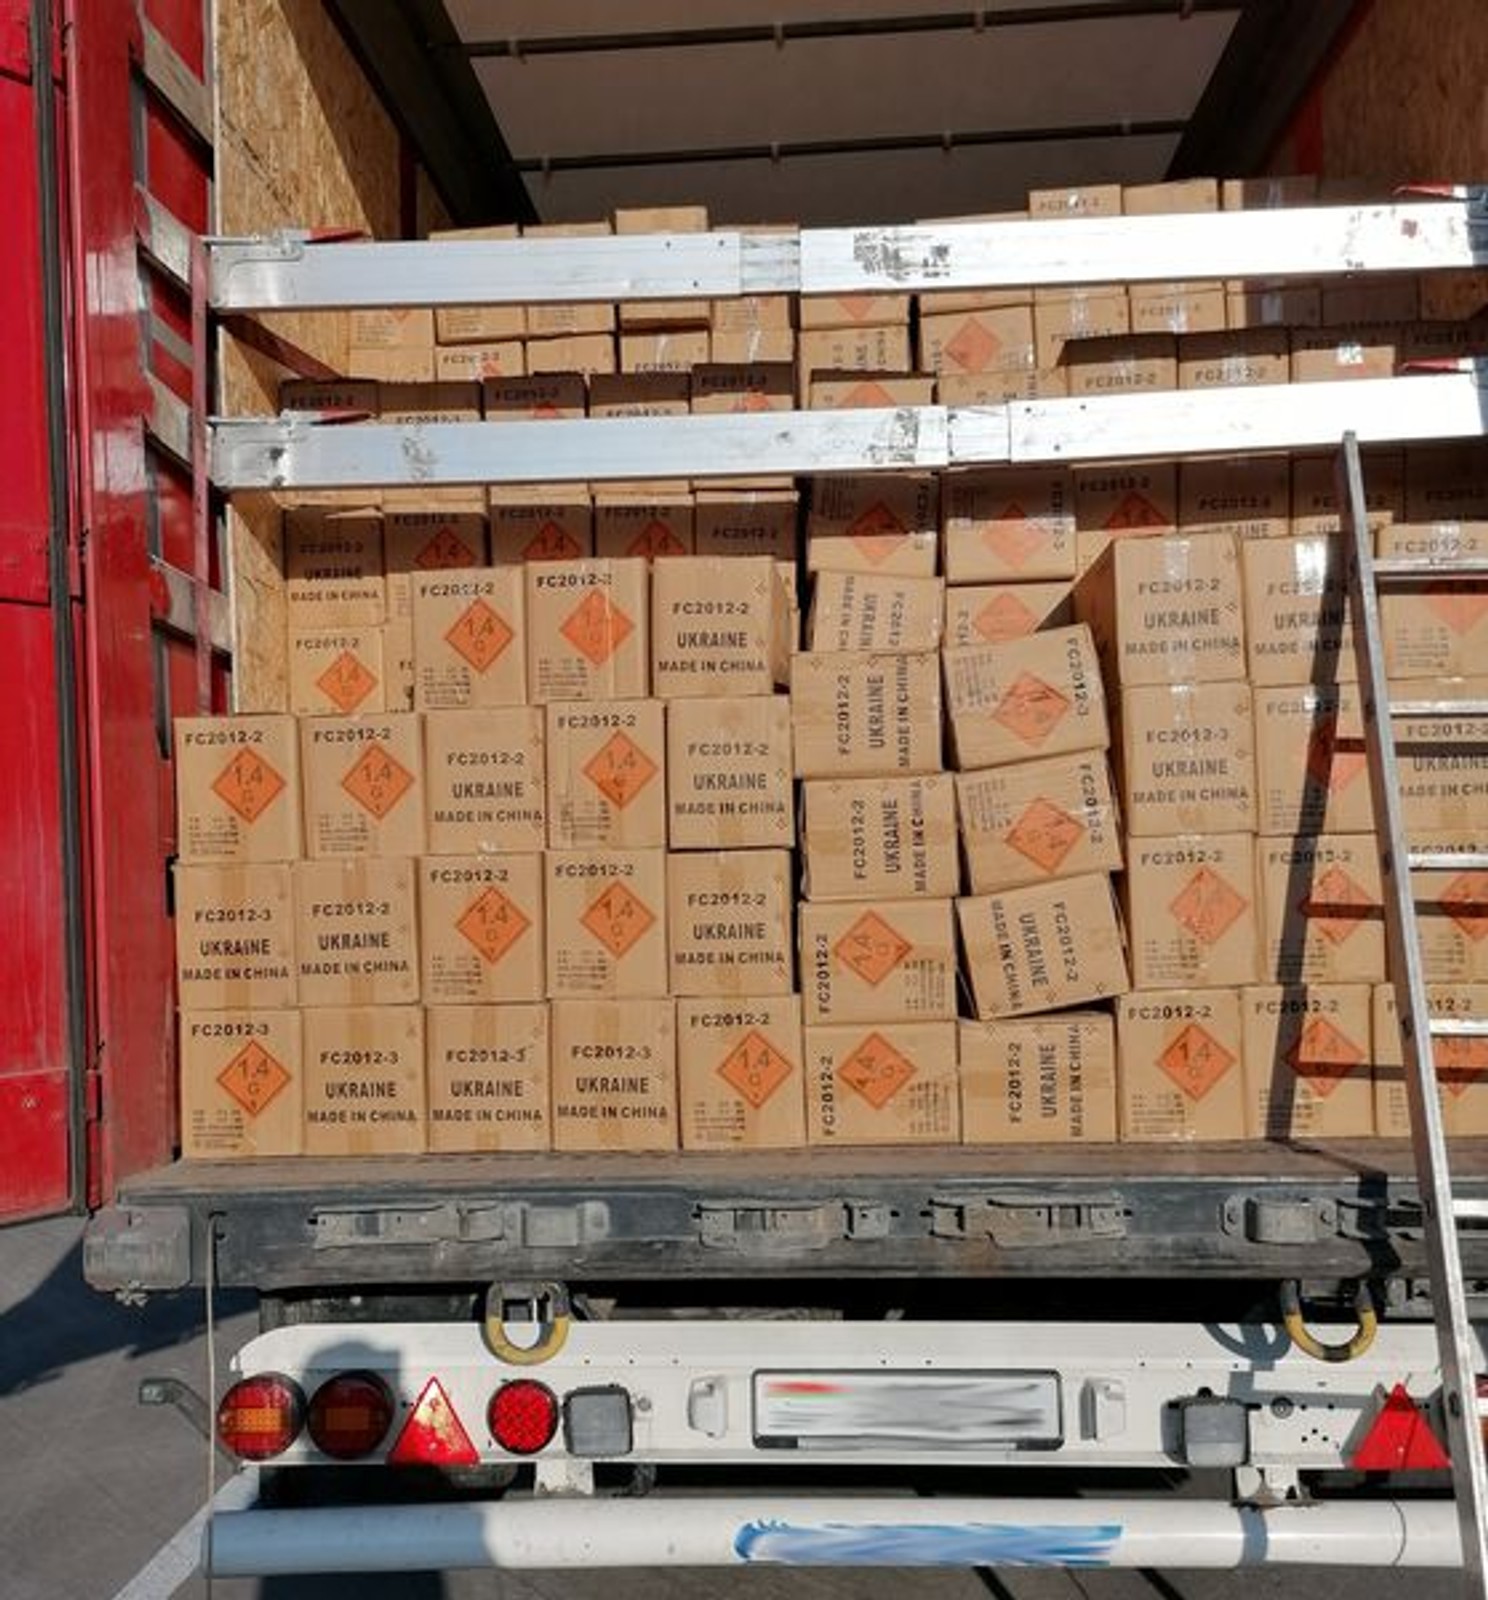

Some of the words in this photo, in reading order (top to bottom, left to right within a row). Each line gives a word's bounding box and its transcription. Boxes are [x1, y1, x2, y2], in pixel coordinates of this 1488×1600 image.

[1138, 578, 1221, 596] FC2012-2
[672, 602, 750, 615] FC2012-2
[1144, 607, 1220, 629] UKRAINE
[677, 632, 748, 649] UKRAINE
[1125, 640, 1169, 655] MADE
[1172, 639, 1188, 653] IN
[1192, 636, 1240, 652] CHINA
[658, 661, 697, 673] MADE
[701, 661, 716, 672] IN
[720, 660, 765, 672] CHINA
[837, 675, 850, 756] FC2012-2
[867, 675, 885, 749] UKRAINE
[896, 705, 909, 723] IN
[558, 715, 637, 729] FC2012-2
[184, 732, 263, 746] FC2012-2
[313, 729, 392, 744] FC2012-2
[688, 744, 769, 756] FC2012-2
[898, 725, 910, 768] MADE
[447, 752, 524, 766] FC2012-2
[1152, 757, 1228, 779] UKRAINE
[452, 782, 524, 798] UKRAINE
[694, 774, 767, 790] UKRAINE
[1133, 791, 1176, 804] MADE
[1179, 789, 1196, 802] IN
[1200, 786, 1249, 801] CHINA
[435, 810, 474, 824] MADE
[477, 810, 493, 823] IN
[496, 809, 543, 823] CHINA
[675, 802, 715, 816] MADE
[718, 802, 735, 815] IN
[738, 801, 785, 814] CHINA
[882, 799, 901, 873] UKRAINE
[431, 869, 509, 883] FC2012-2
[555, 864, 634, 878] FC2012-2
[913, 851, 926, 892] MADE
[688, 893, 766, 907] FC2012-2
[194, 910, 271, 923] FC2012-3
[312, 903, 390, 917] FC2012-2
[693, 924, 765, 940] UKRAINE
[200, 940, 271, 956] UKRAINE
[318, 934, 390, 950] UKRAINE
[1019, 912, 1049, 987] UKRAINE
[676, 952, 715, 965] MADE
[719, 951, 734, 965] IN
[738, 950, 784, 964] CHINA
[999, 943, 1012, 961] IN
[183, 968, 222, 981] MADE
[226, 967, 241, 980] IN
[244, 966, 289, 979] CHINA
[301, 962, 341, 976] MADE
[344, 961, 360, 975] IN
[363, 960, 409, 974] CHINA
[816, 934, 830, 1014] FC2012-2
[691, 1013, 771, 1028] FC2012-2
[1128, 1005, 1212, 1020] FC2012-2
[192, 1023, 269, 1037] FC2012-3
[320, 1052, 398, 1065] FC2012-3
[572, 1046, 652, 1060] FC2012-3
[451, 1080, 524, 1097] UKRAINE
[576, 1077, 649, 1094] UKRAINE
[1008, 1041, 1022, 1124] FC2012-2
[1040, 1043, 1058, 1118] UKRAINE
[1069, 1075, 1082, 1092] IN
[325, 1082, 396, 1098] UKRAINE
[822, 1056, 835, 1136] FC2012-2
[307, 1111, 348, 1124] MADE
[352, 1110, 367, 1123] IN
[370, 1109, 416, 1123] CHINA
[432, 1110, 473, 1123] MADE
[476, 1110, 492, 1123] IN
[496, 1109, 543, 1122] CHINA
[557, 1105, 598, 1119] MADE
[601, 1106, 617, 1119] IN
[620, 1105, 668, 1119] CHINA
[1069, 1095, 1082, 1137] MADE
